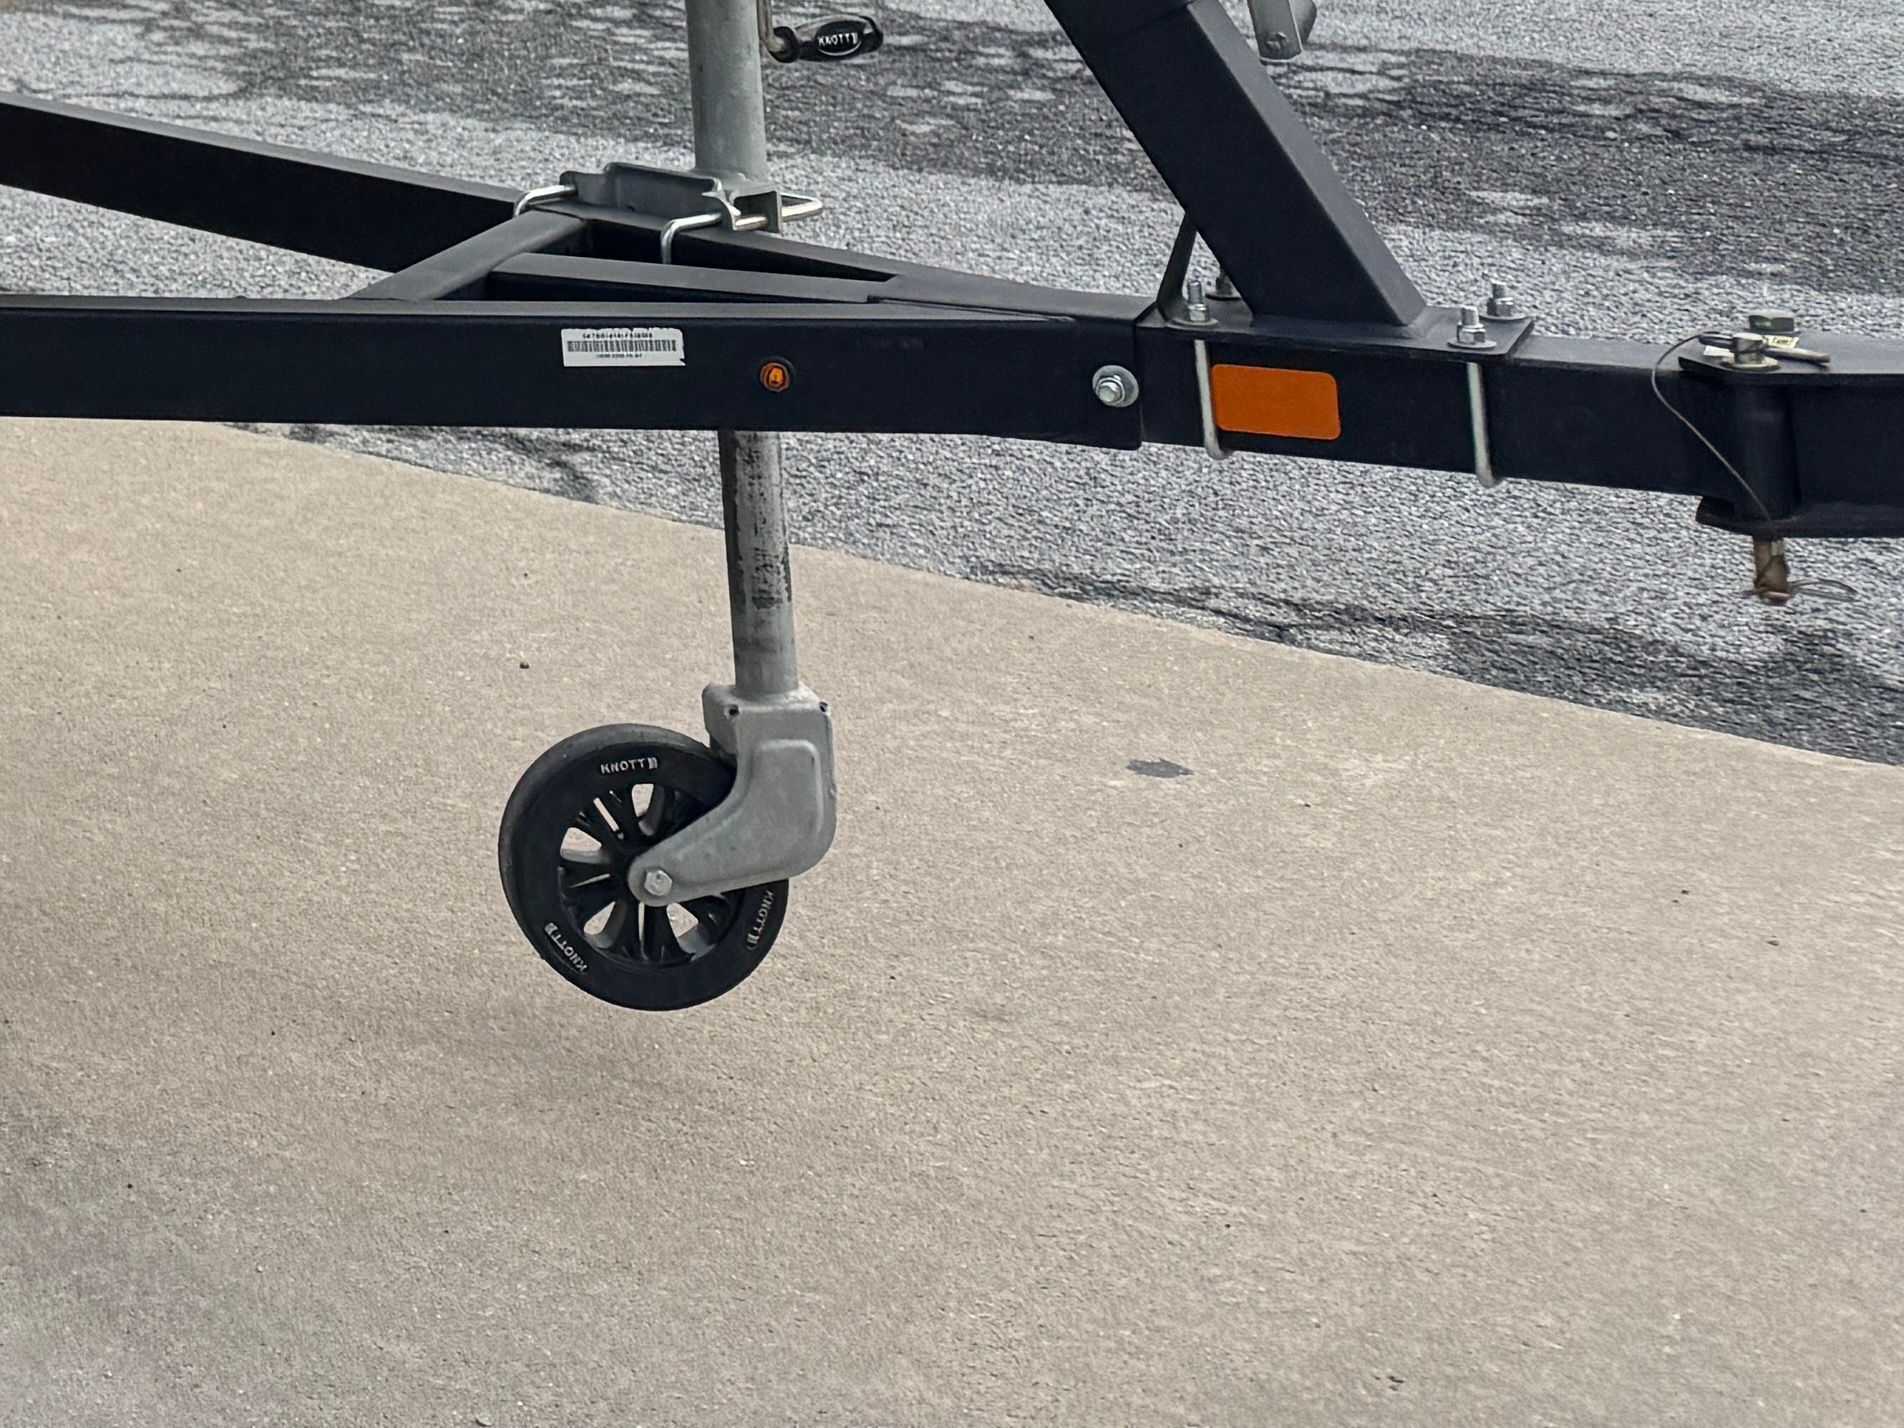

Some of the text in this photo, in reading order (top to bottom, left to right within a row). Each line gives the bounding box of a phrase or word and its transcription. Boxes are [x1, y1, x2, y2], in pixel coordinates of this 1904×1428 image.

[818, 32, 853, 47] KNOTT
[600, 757, 646, 775] KNOTT
[550, 934, 588, 972] KNOTT
